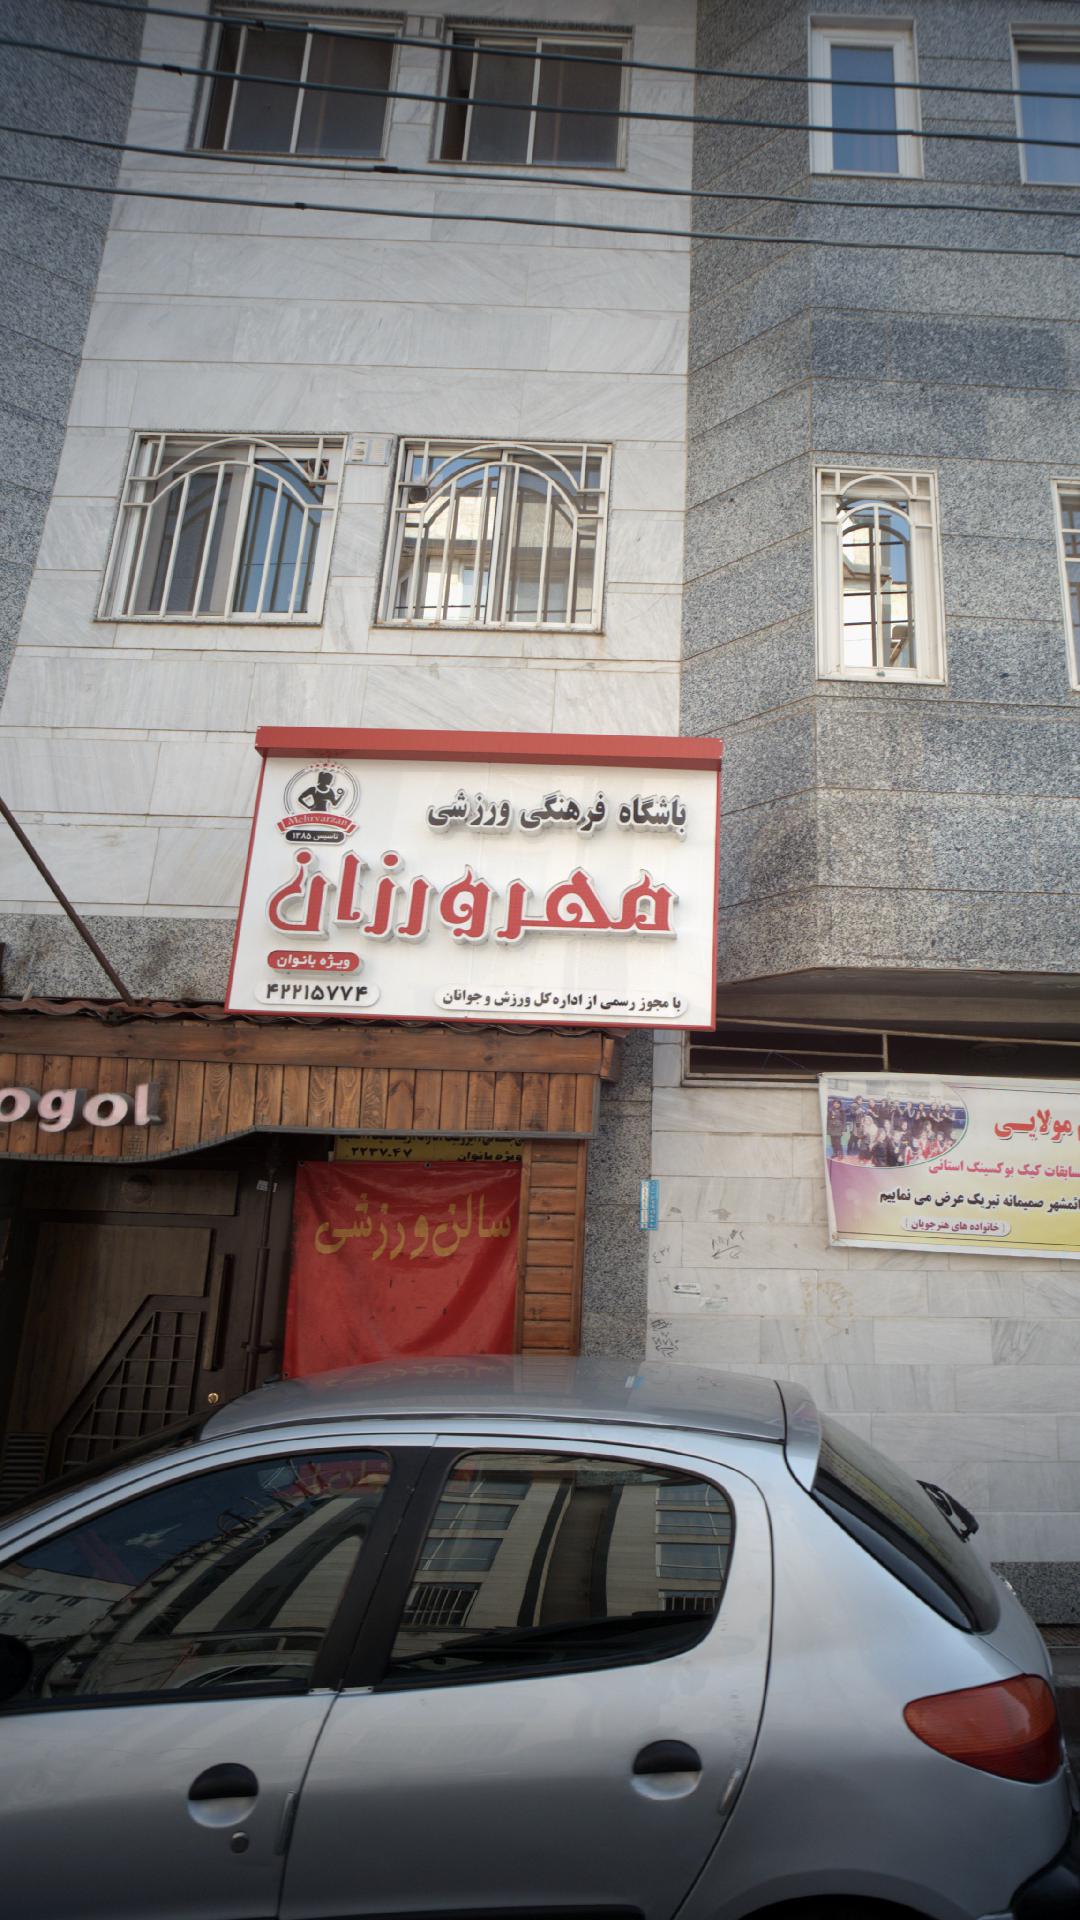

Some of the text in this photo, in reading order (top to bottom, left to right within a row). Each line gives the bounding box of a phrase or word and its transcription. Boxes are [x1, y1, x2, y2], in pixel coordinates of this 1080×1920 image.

[427, 790, 688, 835] باشگاه فرهنگی ورزشی
[292, 832, 339, 841] تاسیس ۱۳۸۵
[266, 848, 678, 940] مهرورزان
[276, 954, 351, 970] ویژه بانوان
[266, 983, 368, 1002] ۴۲۲۱۵۷۷۴
[443, 988, 482, 1006] جوانان
[494, 990, 531, 1007] ورزش
[533, 992, 553, 1007] کل
[554, 993, 583, 1009] اداره
[585, 994, 597, 1010] از
[600, 997, 636, 1012] رسمی
[638, 997, 669, 1012] مجوز
[672, 997, 682, 1012] با
[994, 1108, 1073, 1142] مولایی
[914, 1194, 932, 1206] می
[935, 1191, 964, 1207] عرض
[967, 1192, 1000, 1210] تبریک
[1003, 1194, 1044, 1211] صمیمانه
[314, 1192, 512, 1261] سالن ورزشی
[951, 1221, 968, 1232] های
[969, 1222, 999, 1234] خانواده
